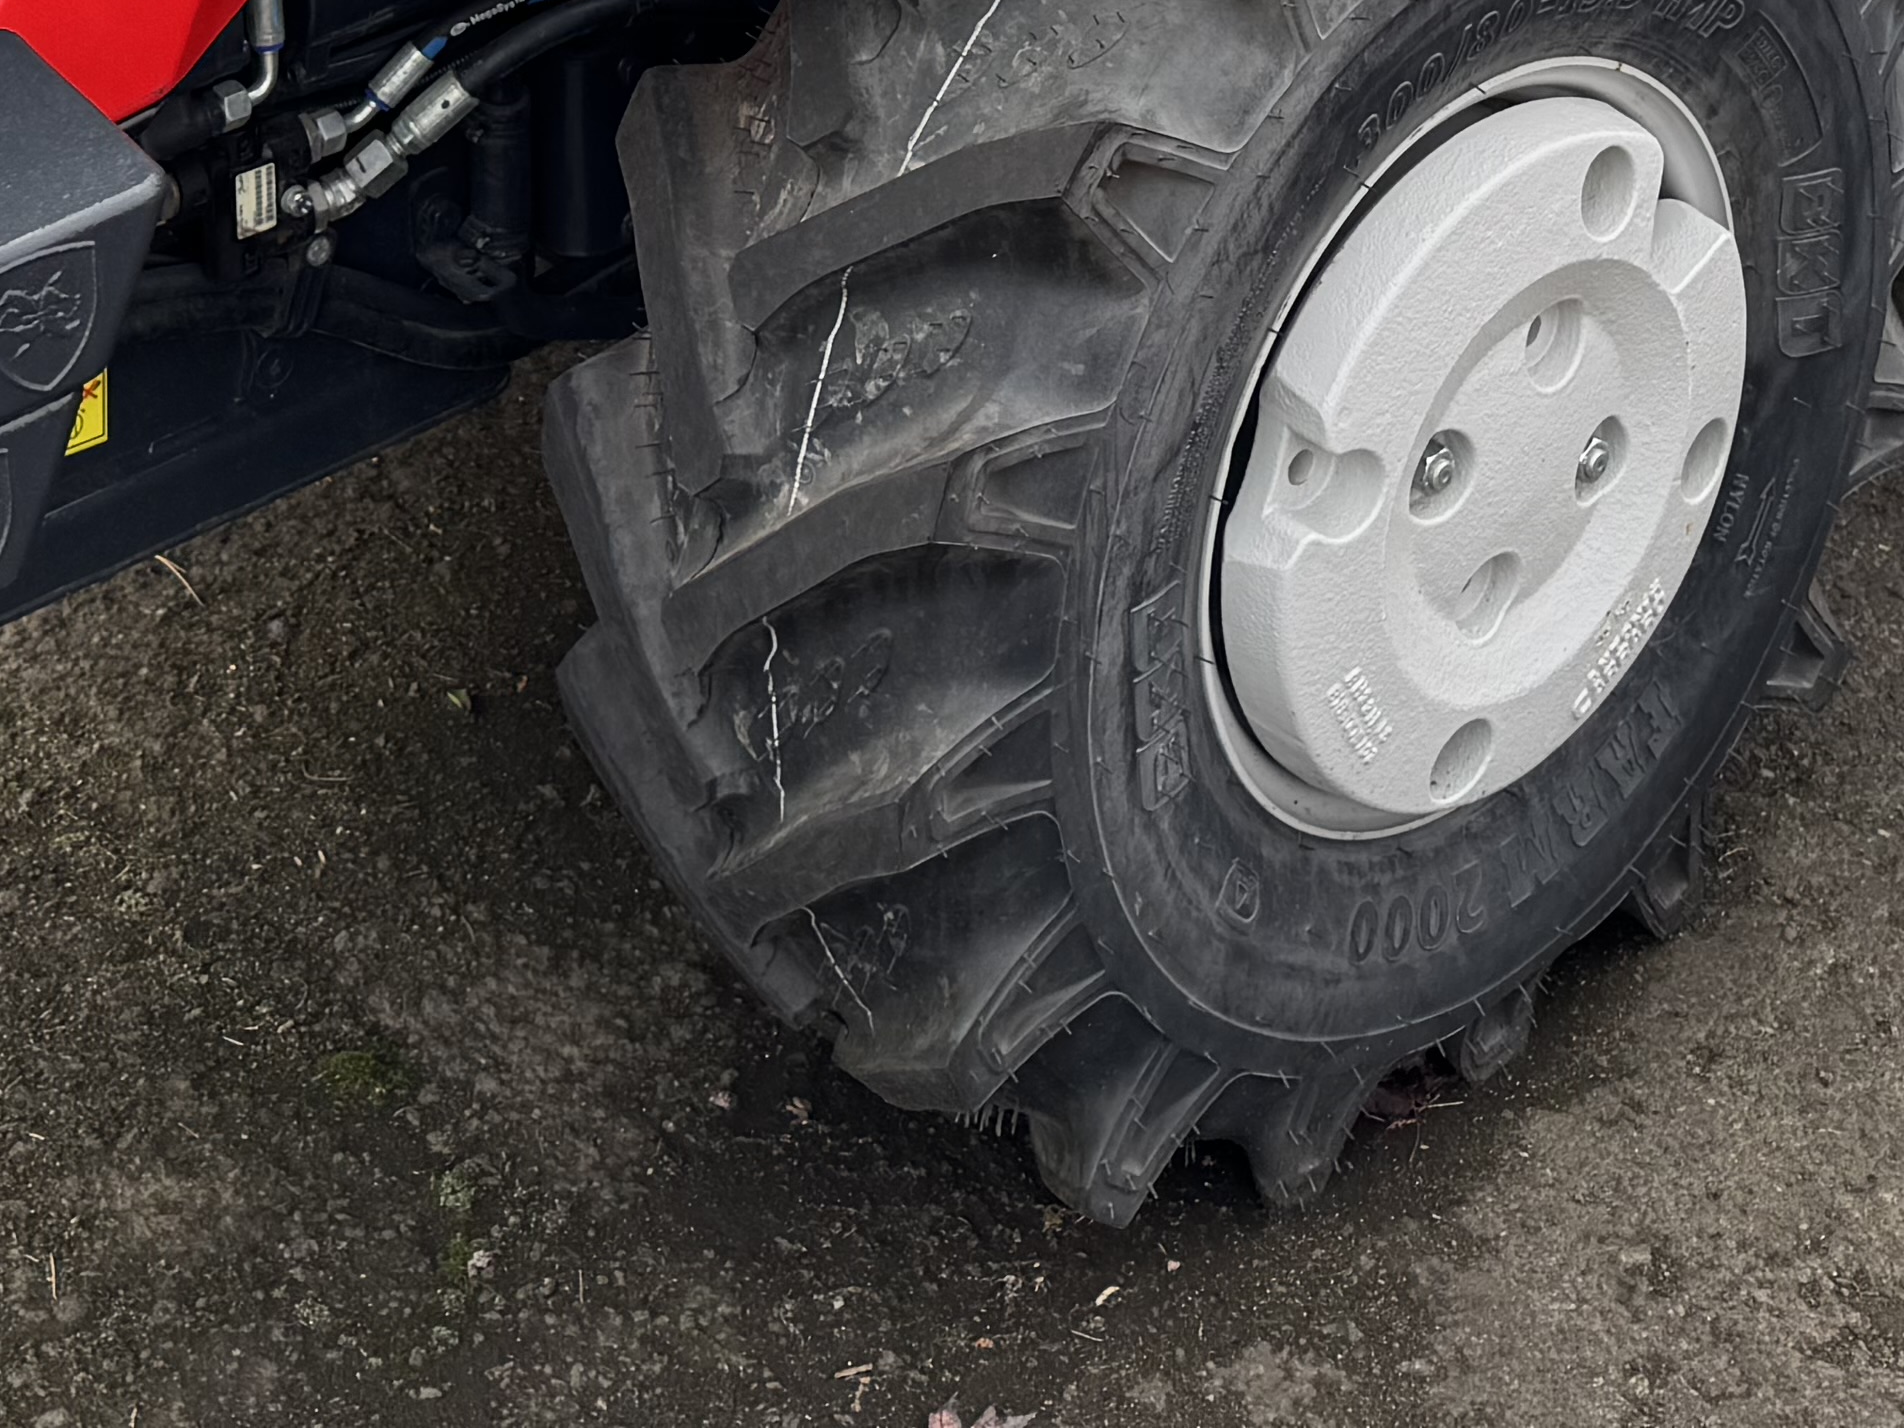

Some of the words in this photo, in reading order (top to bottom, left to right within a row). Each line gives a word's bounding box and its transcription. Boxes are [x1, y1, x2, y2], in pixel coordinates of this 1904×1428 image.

[1780, 171, 1845, 354] BKT
[1712, 472, 1751, 543] NYLON
[1498, 676, 1684, 908] FARM
[1348, 859, 1487, 967] 2000
